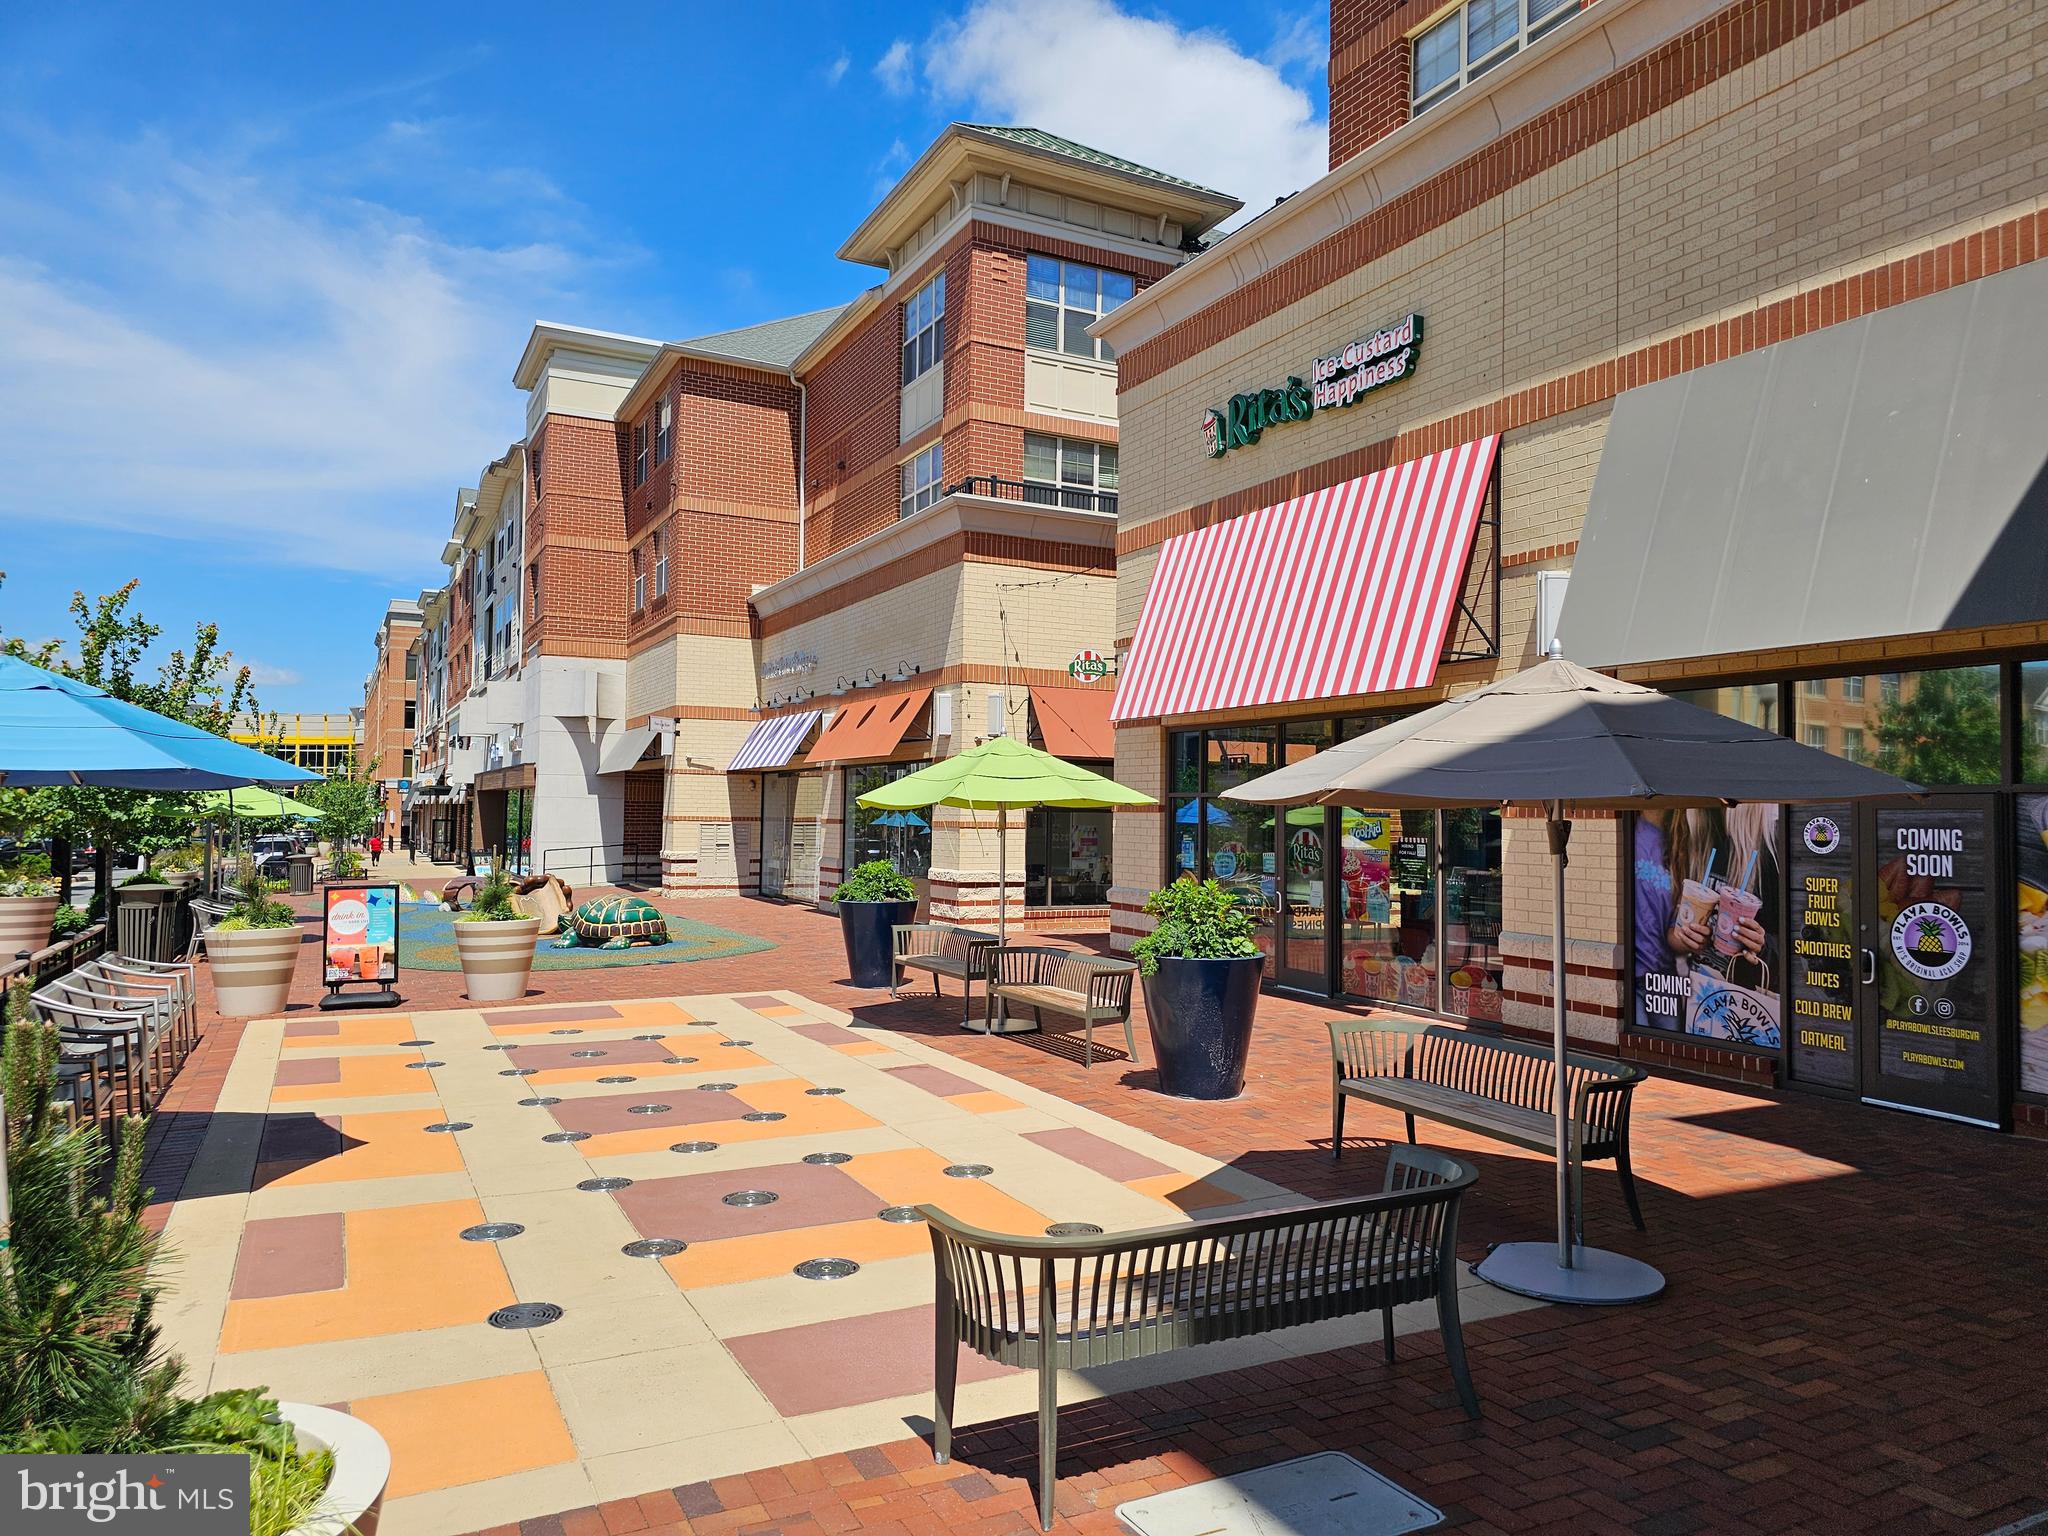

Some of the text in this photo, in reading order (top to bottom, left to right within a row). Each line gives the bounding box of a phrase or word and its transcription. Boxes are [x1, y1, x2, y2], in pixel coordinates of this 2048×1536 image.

[1313, 347, 1411, 410] Happiness
[1228, 375, 1314, 450] Rita's
[1074, 659, 1103, 673] Rita's
[1896, 828, 1963, 852] COMING
[1293, 843, 1320, 862] Rita's
[1906, 854, 1953, 878] SOON
[1805, 877, 1839, 894] SUPER
[1808, 894, 1837, 910] FRUIT
[1804, 911, 1841, 928] BOWLS
[1894, 904, 1969, 940] PLAYA BOWLS
[1794, 939, 1851, 960] SMOOTHIES
[1905, 959, 1937, 978] ORIGINAL
[1953, 951, 1967, 968] SHOP
[1645, 972, 1691, 997] COMING
[1805, 971, 1840, 989] JUICES
[1645, 994, 1678, 1017] SOON
[1795, 999, 1853, 1022] COLD BREW
[1703, 994, 1780, 1046] PLAYA BOWLS
[1800, 1029, 1847, 1052] OATMEAL
[1902, 1051, 1965, 1071] PLAYABOWLS.COM
